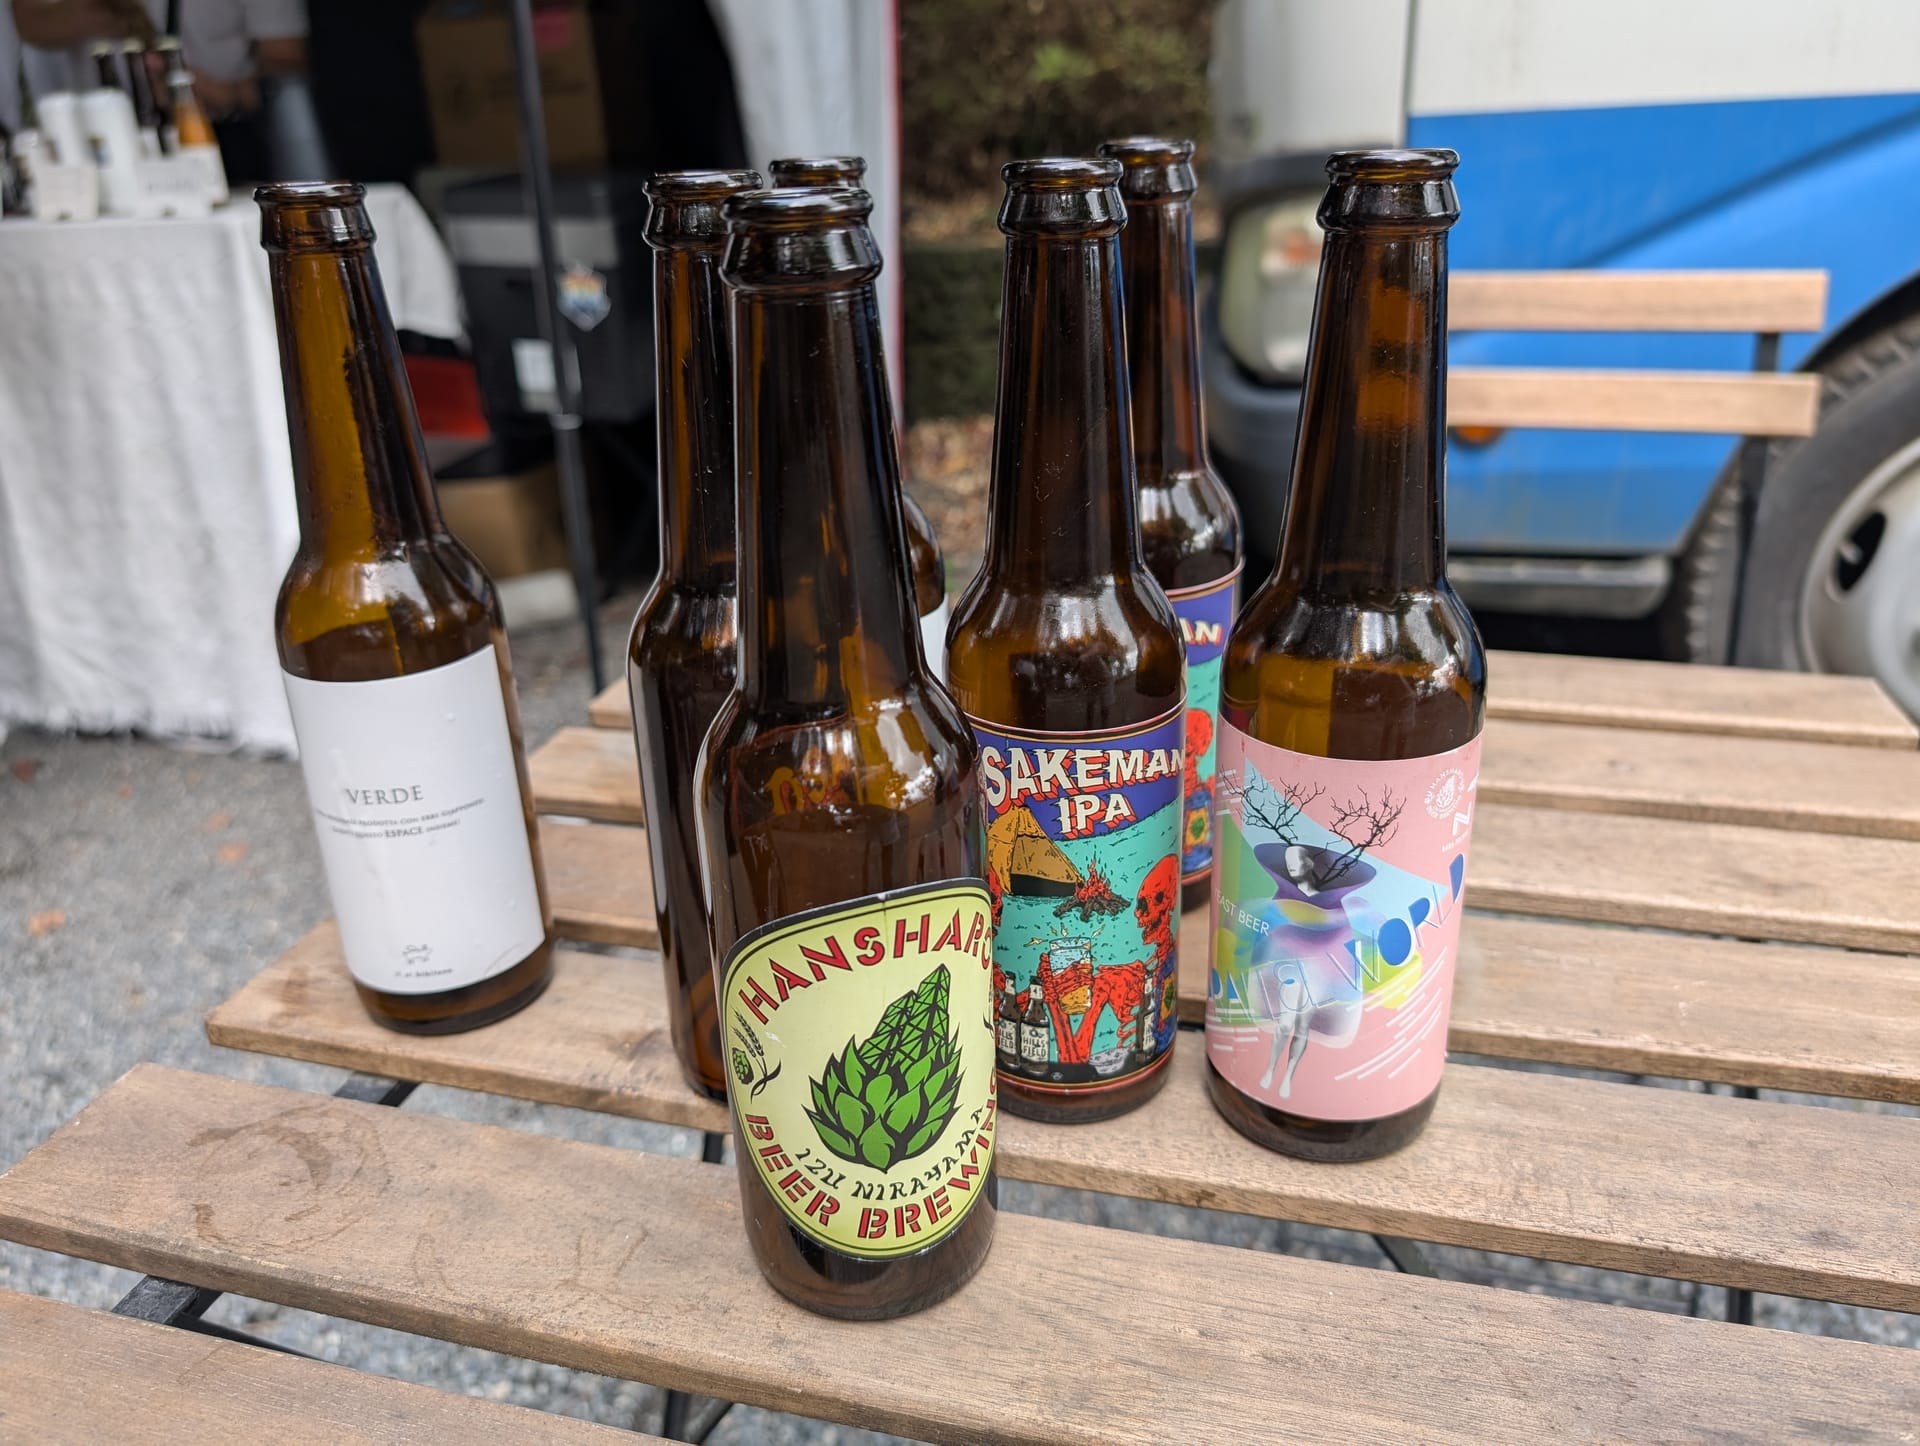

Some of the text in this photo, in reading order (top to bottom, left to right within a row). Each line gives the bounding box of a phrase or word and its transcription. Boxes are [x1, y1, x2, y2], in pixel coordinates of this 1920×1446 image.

[345, 785, 424, 805] VERDE
[981, 745, 1185, 813] SAKEMAN
[1056, 793, 1137, 839] IPA
[1238, 909, 1270, 937] BEER
[745, 1113, 841, 1226] BEER
[796, 1106, 984, 1200] IZU NIRAYAMA
